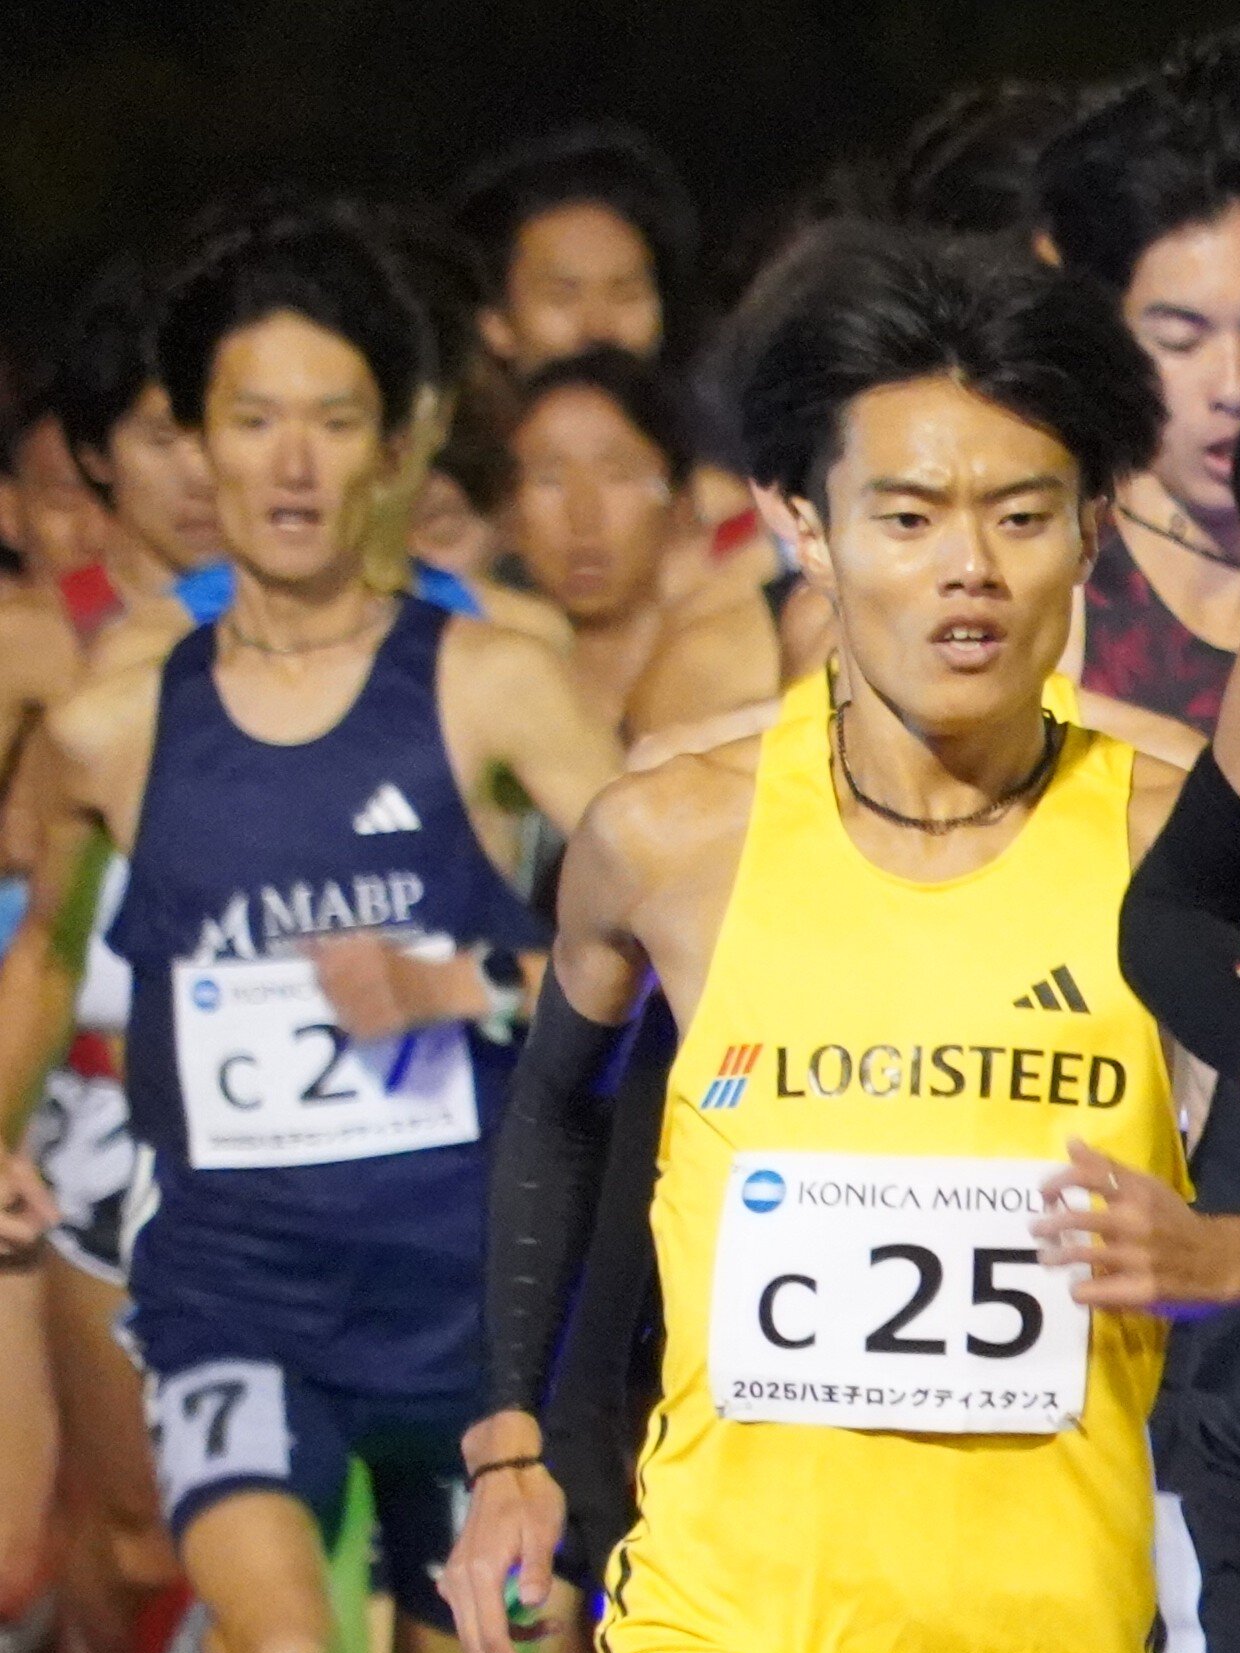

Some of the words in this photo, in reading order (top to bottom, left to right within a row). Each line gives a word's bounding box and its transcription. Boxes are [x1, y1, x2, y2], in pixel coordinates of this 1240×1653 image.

[259, 872, 425, 935] MABP
[216, 1055, 262, 1112] C
[774, 1044, 1128, 1109] LOGISTEED
[798, 1182, 921, 1210] KONICA
[757, 1274, 818, 1350] C
[865, 1244, 1045, 1359] 25
[732, 1379, 1060, 1411] 2025八王子ロングディスタンス
